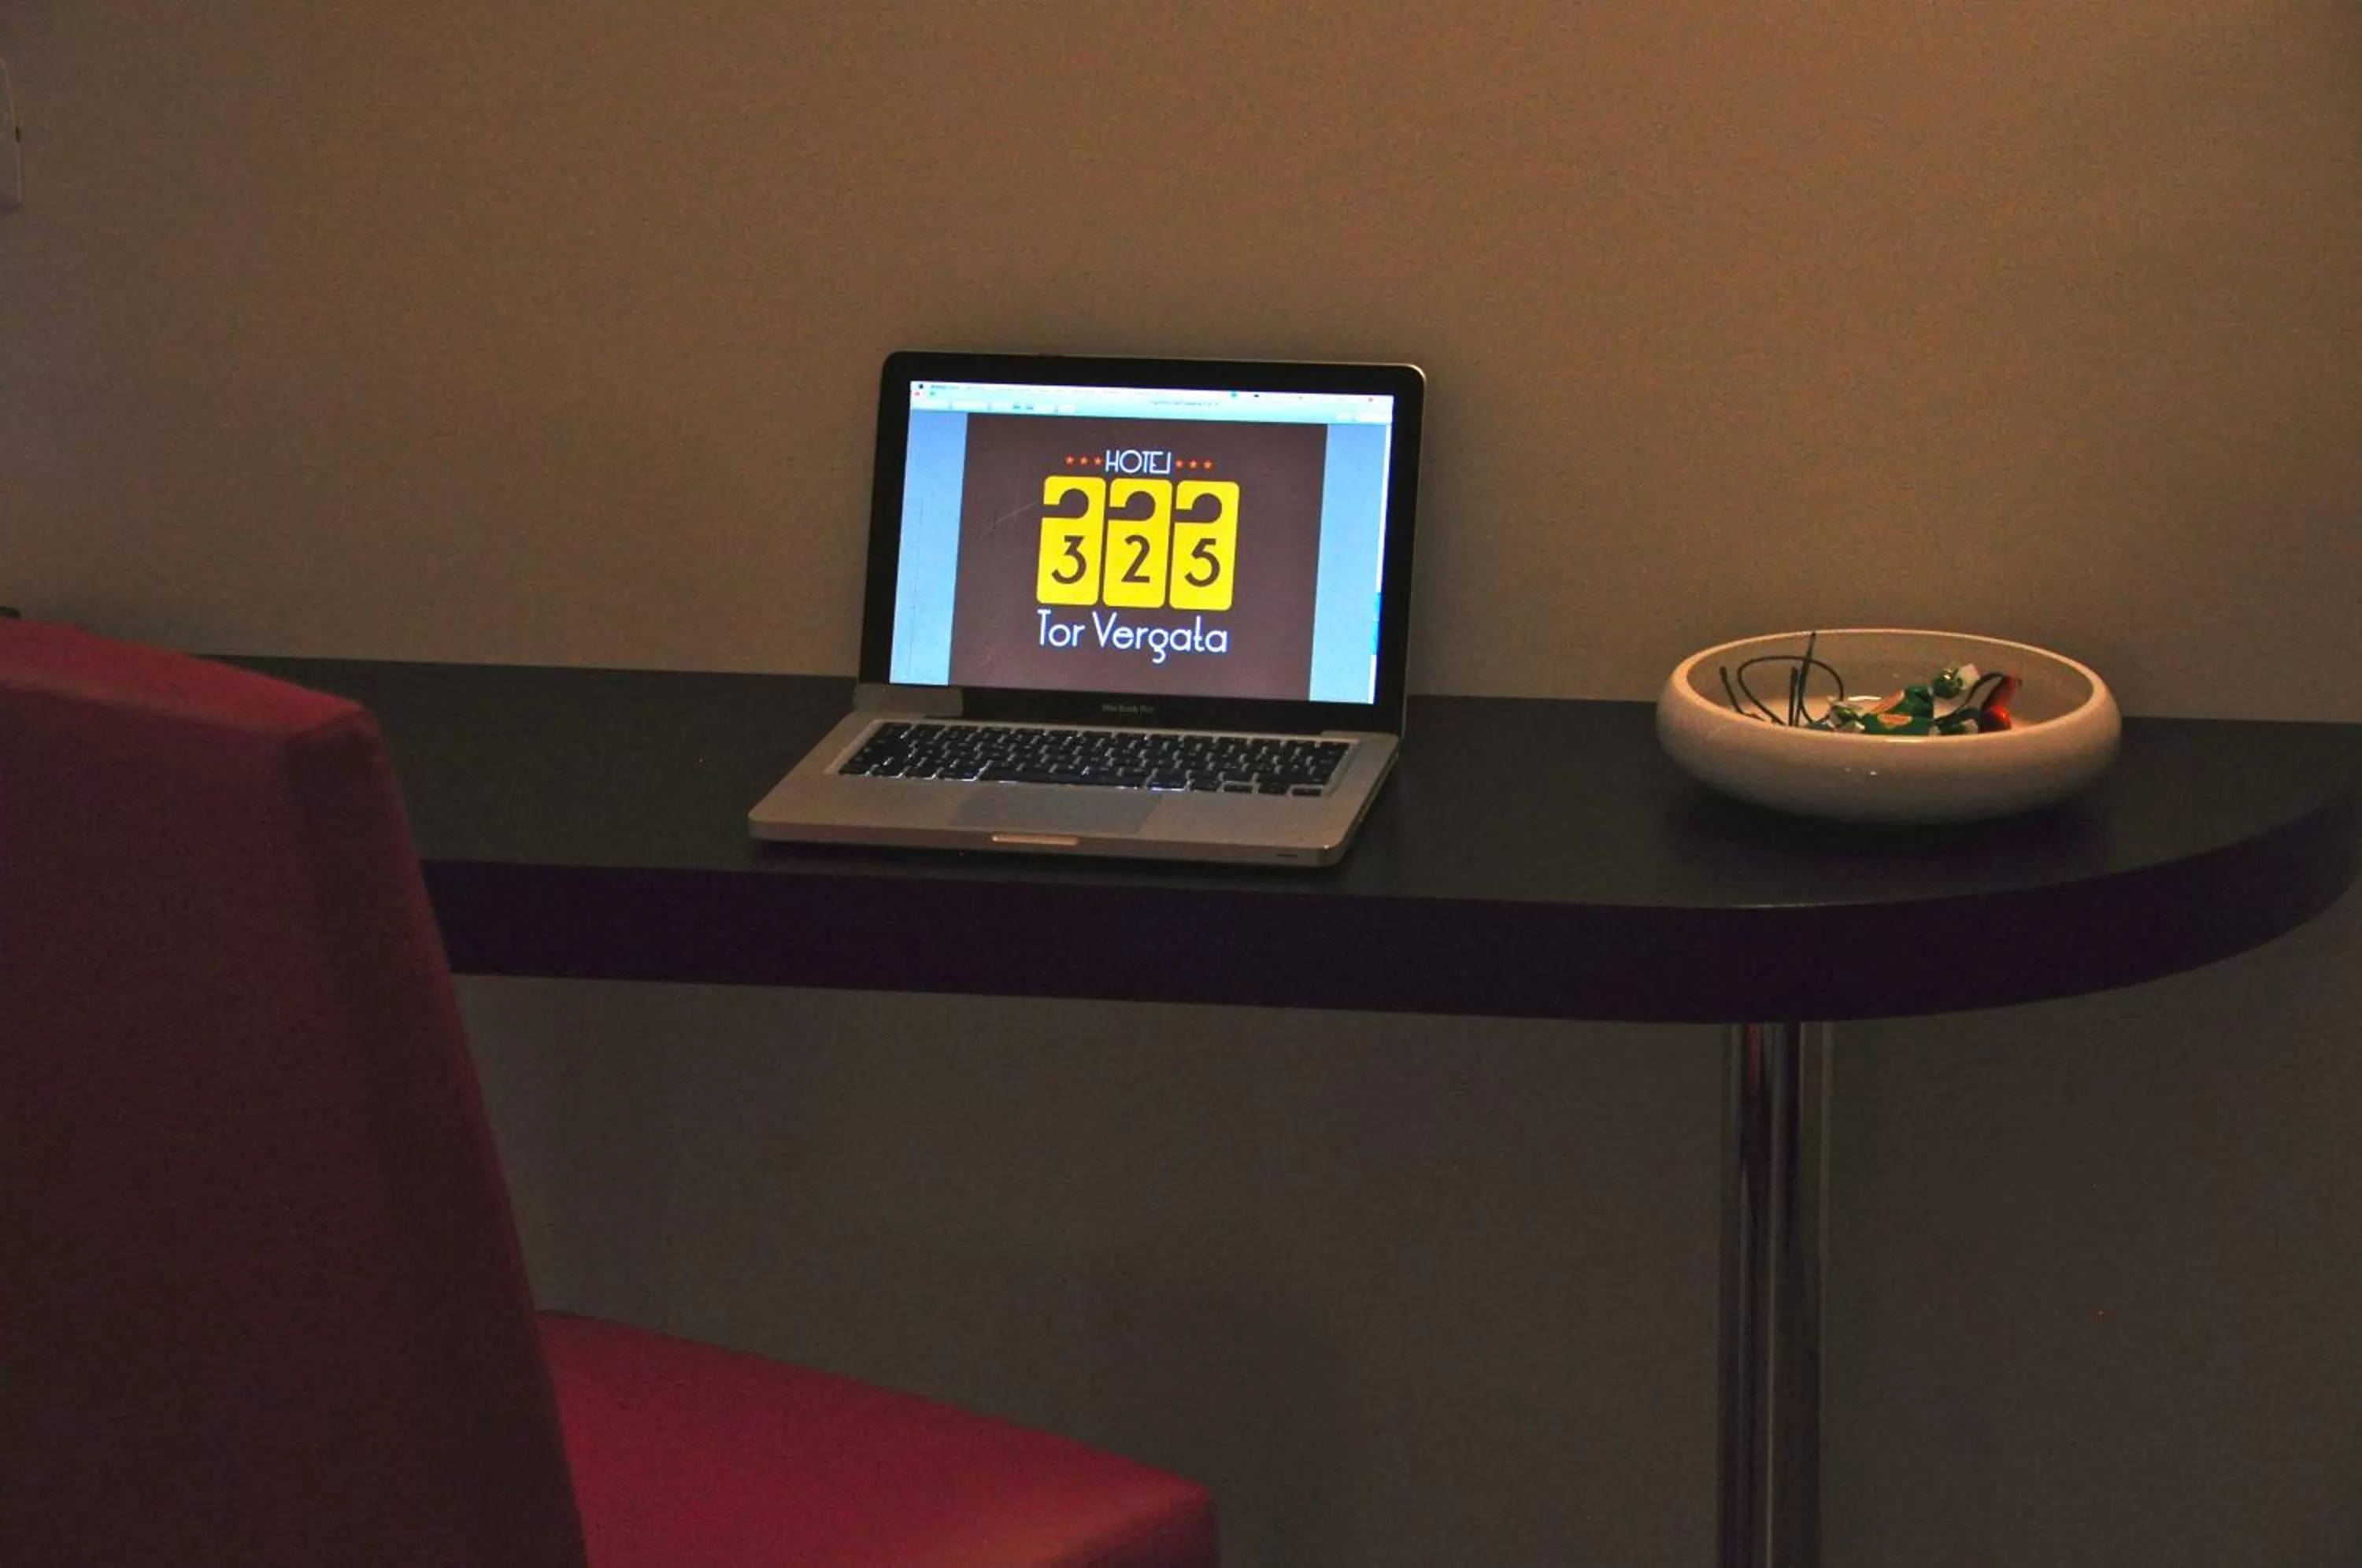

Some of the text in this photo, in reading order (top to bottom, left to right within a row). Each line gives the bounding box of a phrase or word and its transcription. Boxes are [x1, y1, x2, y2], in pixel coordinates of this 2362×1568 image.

[1105, 449, 1172, 474] HOTEL
[1037, 608, 1227, 664] Tor Vergata
